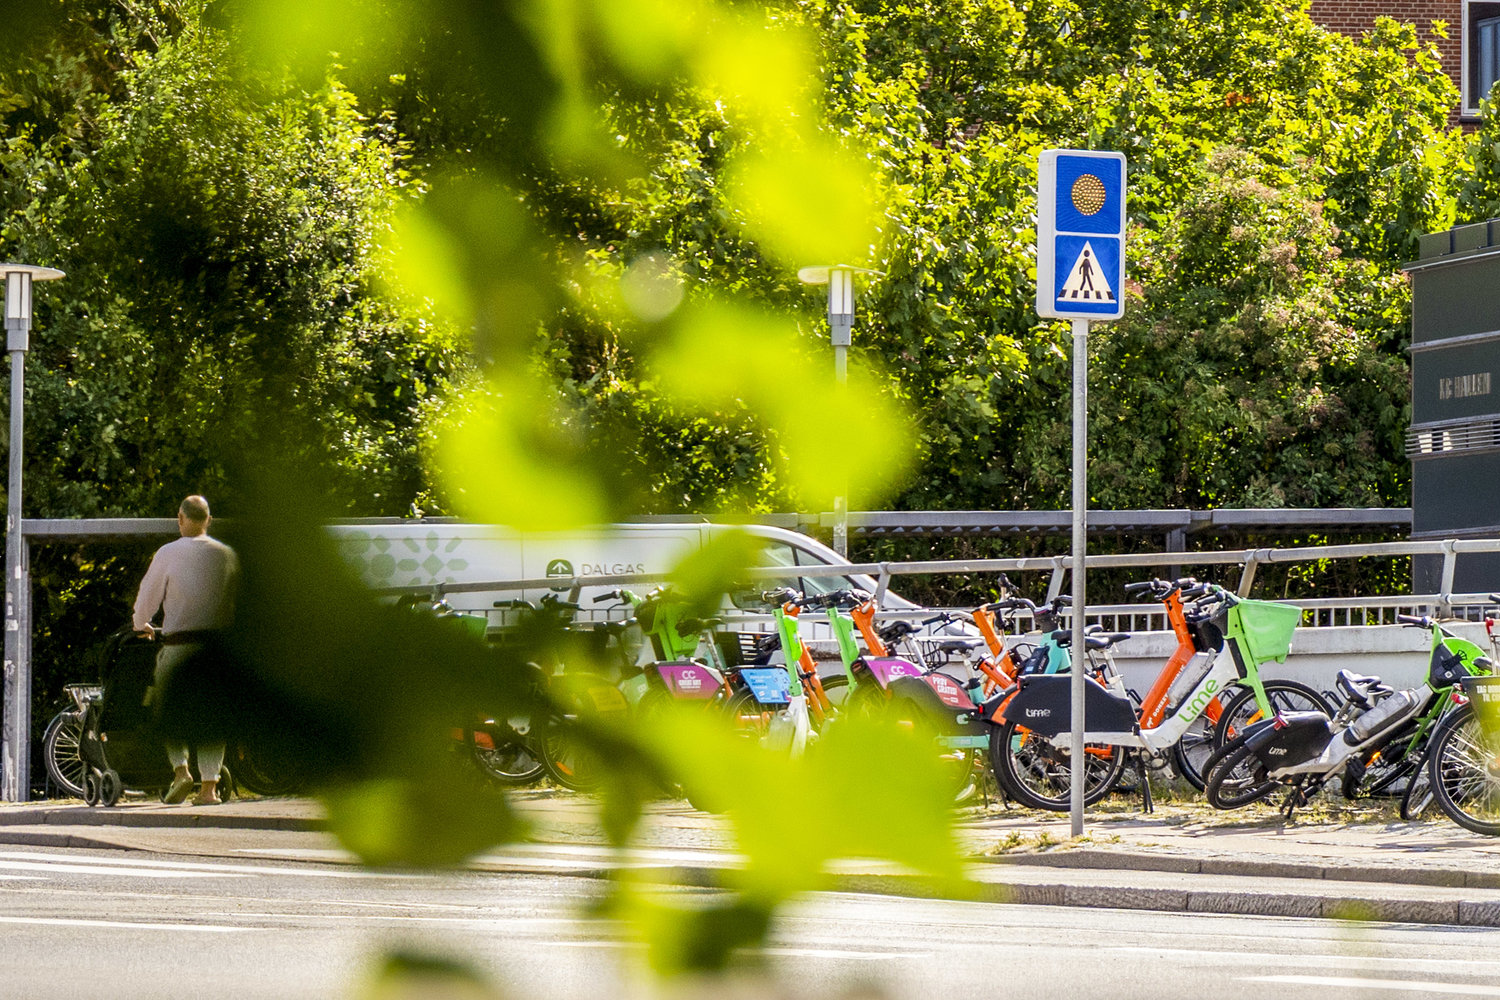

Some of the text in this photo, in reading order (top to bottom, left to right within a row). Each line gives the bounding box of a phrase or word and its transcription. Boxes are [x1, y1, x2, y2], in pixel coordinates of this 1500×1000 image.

[581, 563, 645, 576] DALGAS
[890, 665, 905, 675] CC
[1178, 679, 1219, 722] Lime
